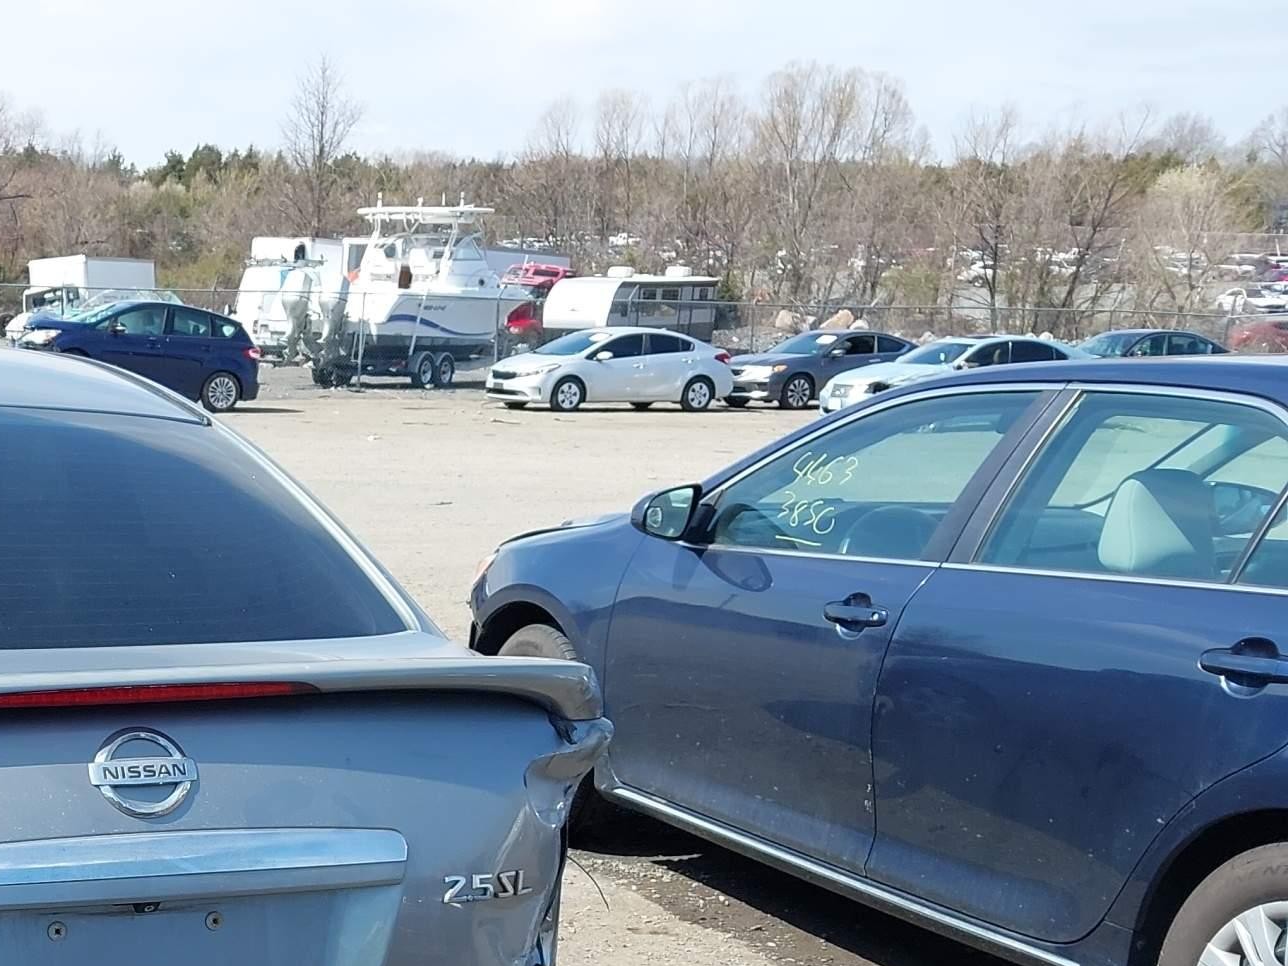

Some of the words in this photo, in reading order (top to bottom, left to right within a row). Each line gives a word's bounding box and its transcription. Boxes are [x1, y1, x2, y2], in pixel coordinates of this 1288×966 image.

[792, 451, 858, 486] 4463
[776, 490, 836, 535] 3850
[102, 762, 187, 780] NISSAN
